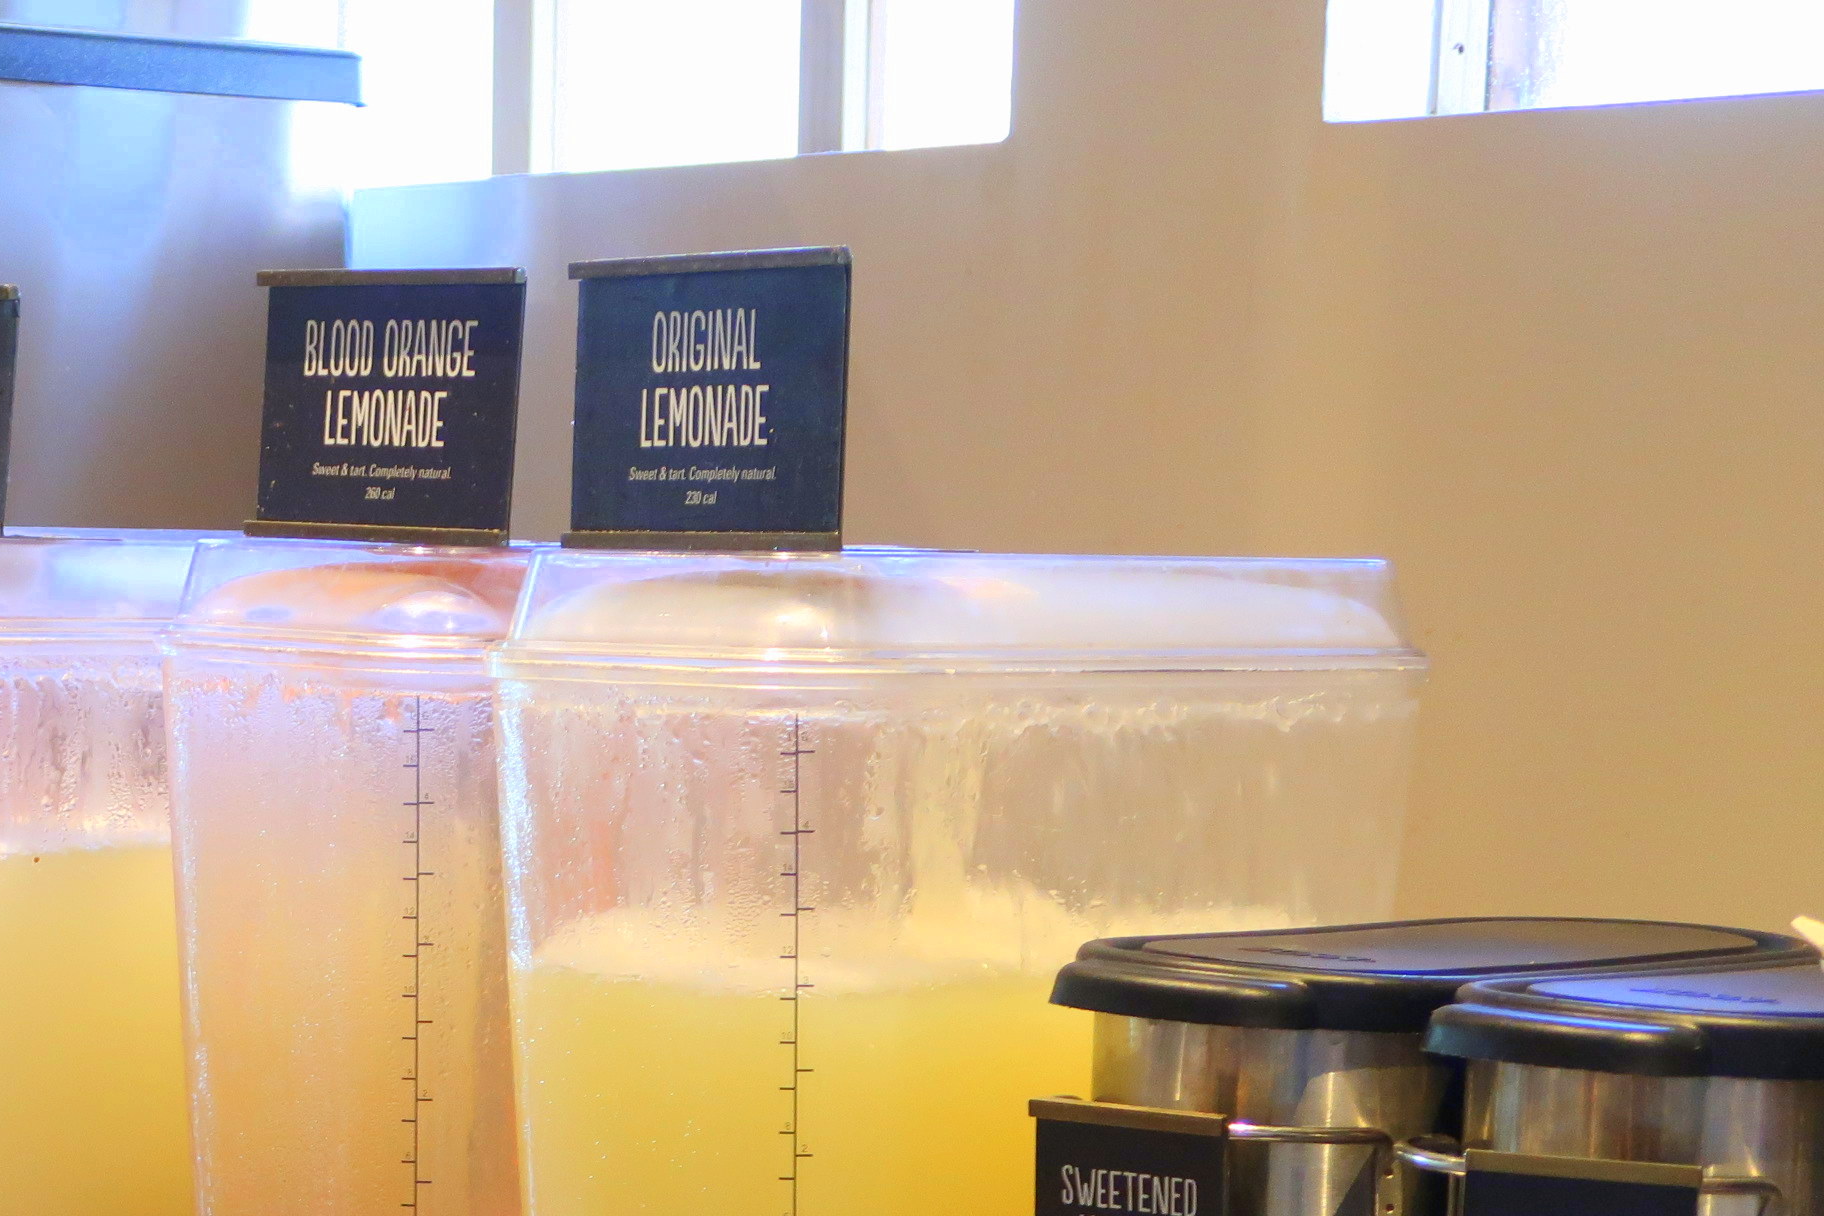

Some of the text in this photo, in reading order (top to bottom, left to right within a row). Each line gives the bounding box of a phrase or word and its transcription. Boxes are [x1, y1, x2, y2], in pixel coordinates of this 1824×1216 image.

[303, 318, 479, 379] BLOOD ORANGE
[651, 307, 762, 374] ORIGINAL
[323, 388, 448, 448] LEMONADE
[640, 384, 770, 448] LEMONADE
[311, 461, 340, 477] Sweet
[340, 462, 349, 477] &
[368, 463, 417, 481] Completely
[627, 465, 658, 481] Sweet
[658, 465, 667, 481] &
[688, 465, 740, 483] Completely
[381, 487, 396, 501] cal
[702, 490, 717, 505] cal
